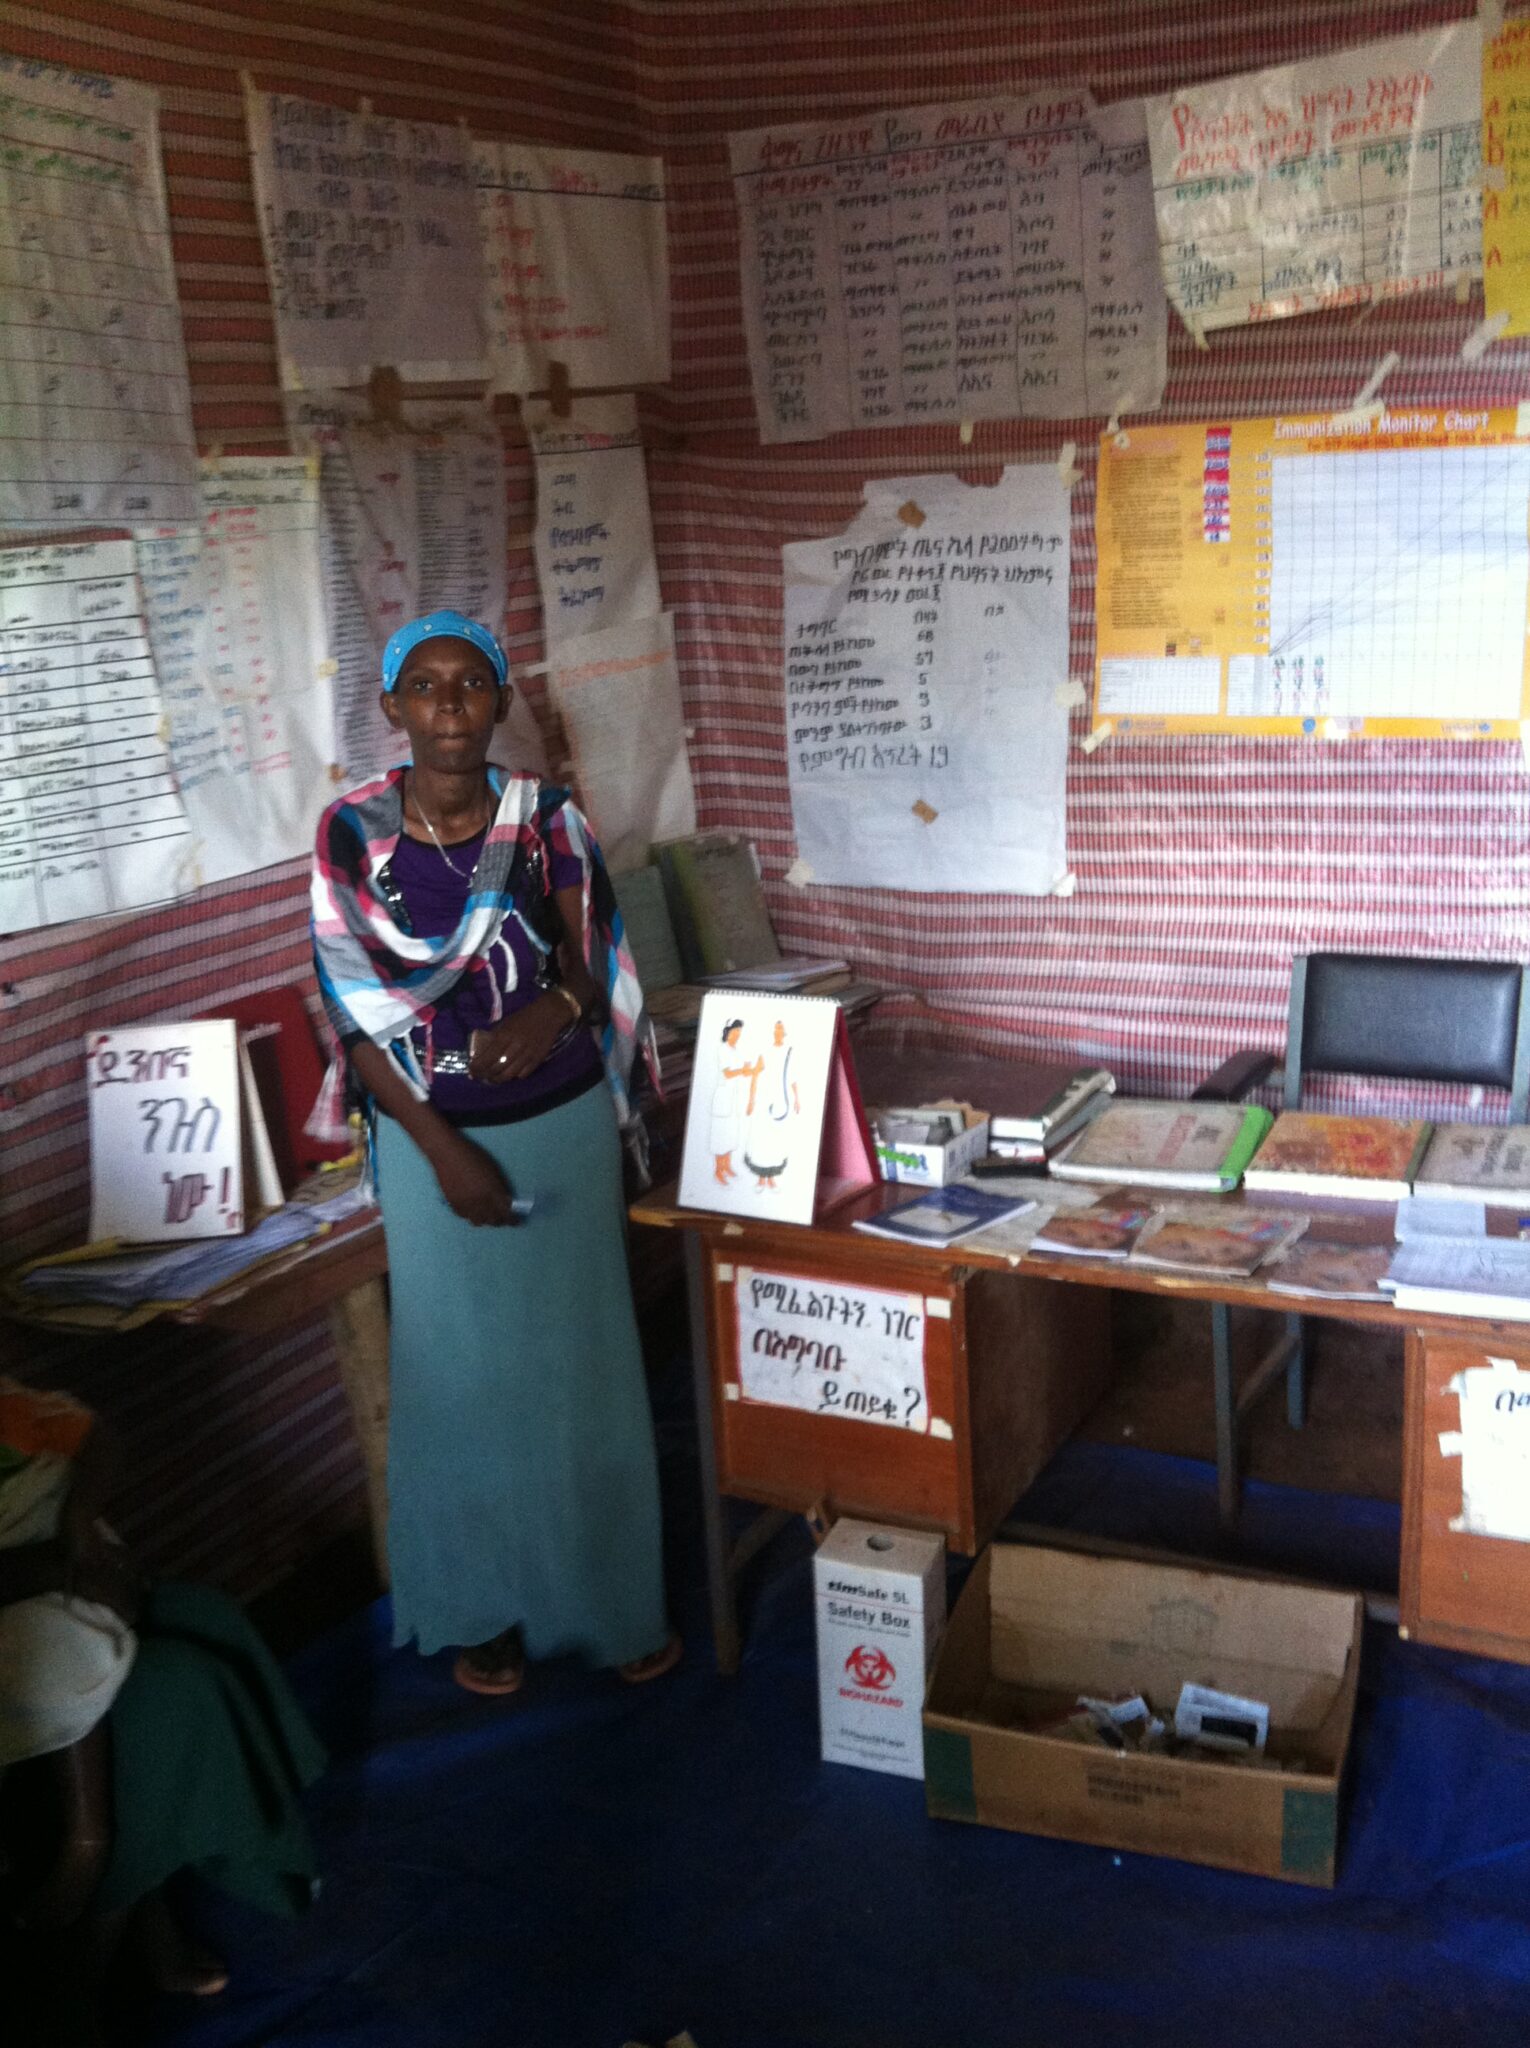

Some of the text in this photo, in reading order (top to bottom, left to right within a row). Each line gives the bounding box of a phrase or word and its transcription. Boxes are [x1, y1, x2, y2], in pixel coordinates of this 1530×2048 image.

[1378, 411, 1437, 434] Monitor
[1443, 410, 1489, 431] Chart
[828, 1602, 876, 1626] Safety
[882, 1611, 911, 1629] Box
